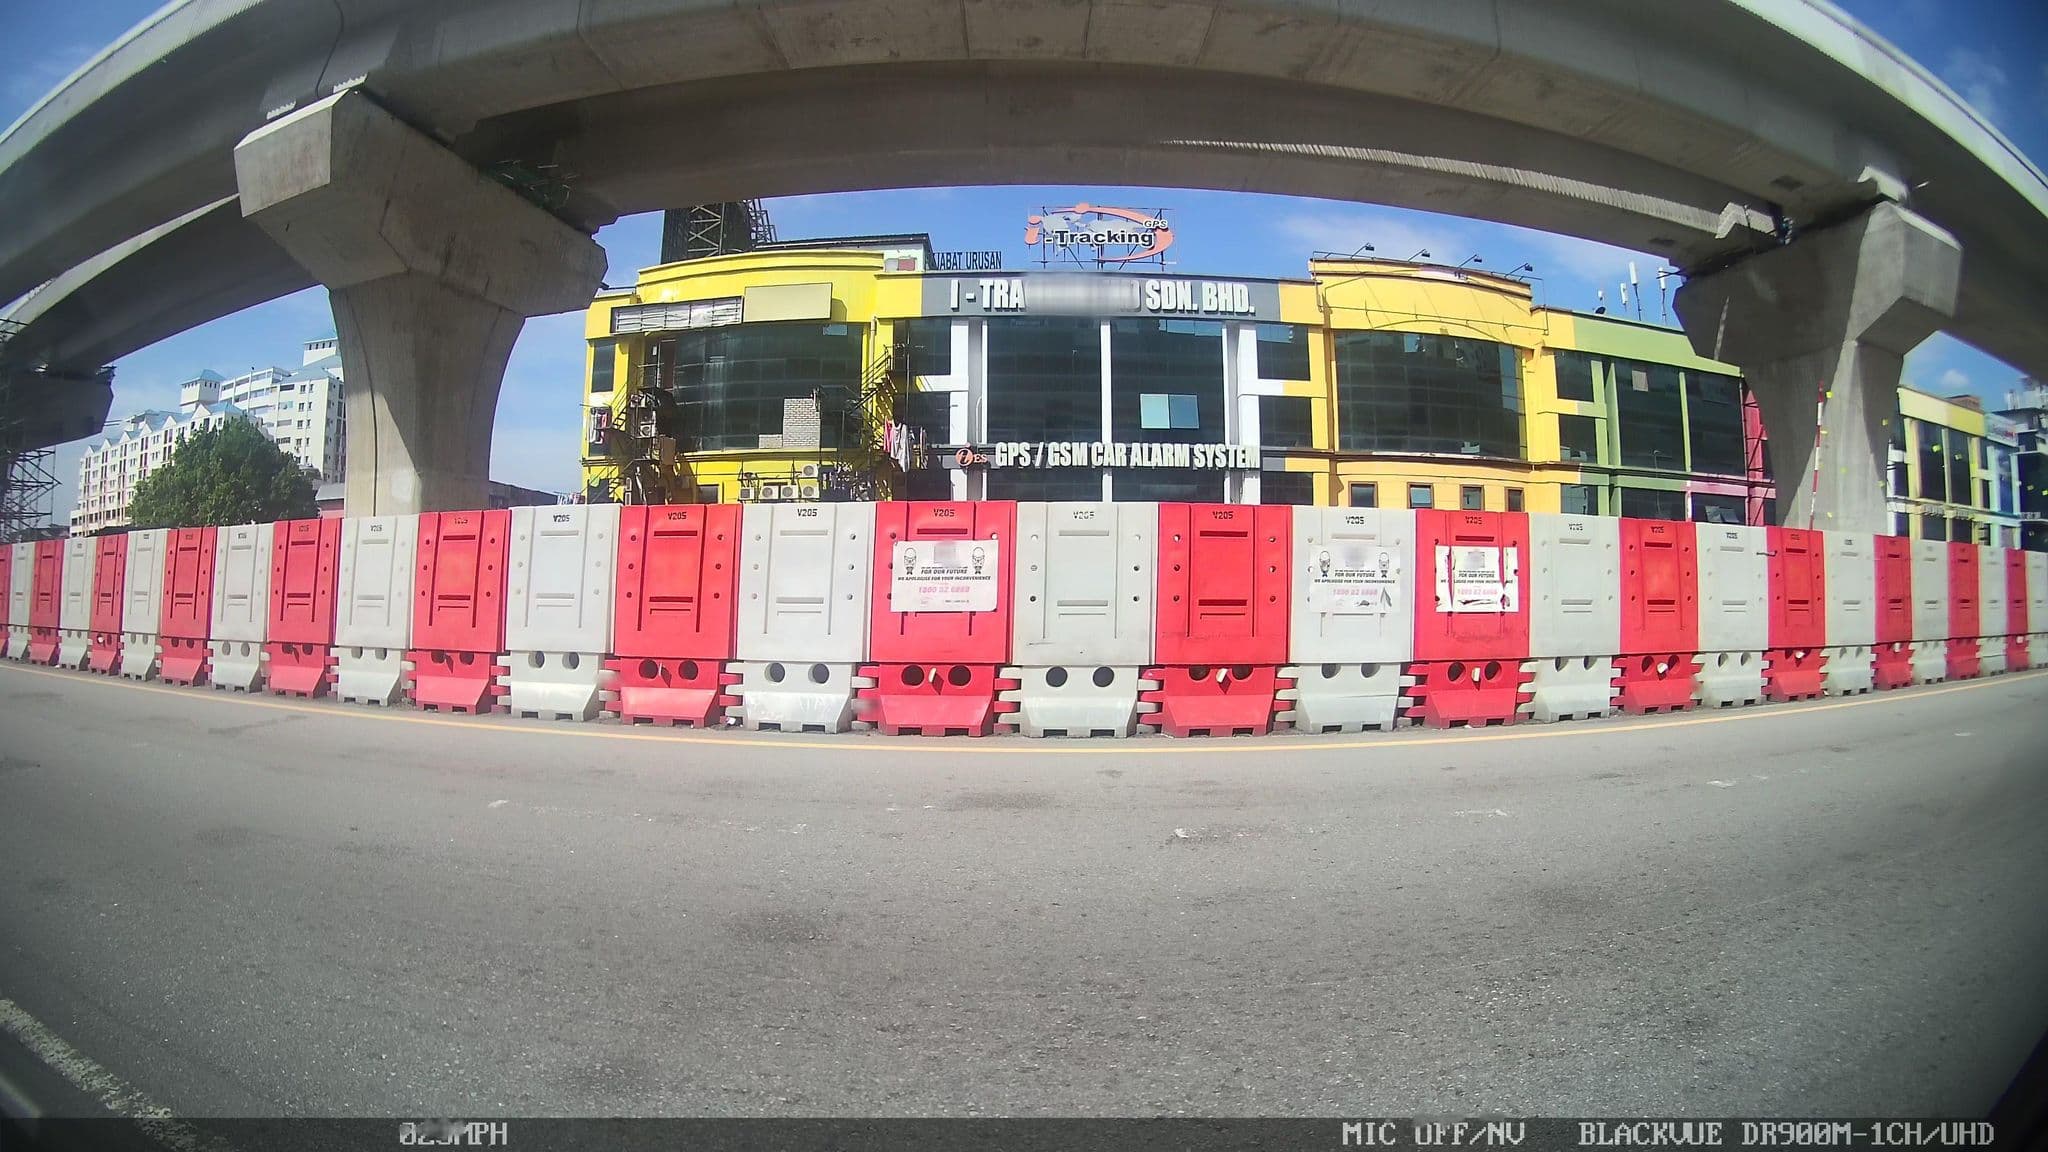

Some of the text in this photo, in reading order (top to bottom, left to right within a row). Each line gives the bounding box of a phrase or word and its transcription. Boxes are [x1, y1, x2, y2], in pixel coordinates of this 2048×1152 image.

[1143, 220, 1168, 228] GPS
[933, 251, 1002, 270] JABAT URUSAN
[1145, 279, 1198, 312] SDN.
[1201, 280, 1256, 315] BHD.
[995, 442, 1031, 467] GPS
[1048, 442, 1088, 467] GSM
[1091, 442, 1127, 467] CAR
[1130, 443, 1190, 467] ALARM
[1193, 443, 1261, 469] SYSTEM
